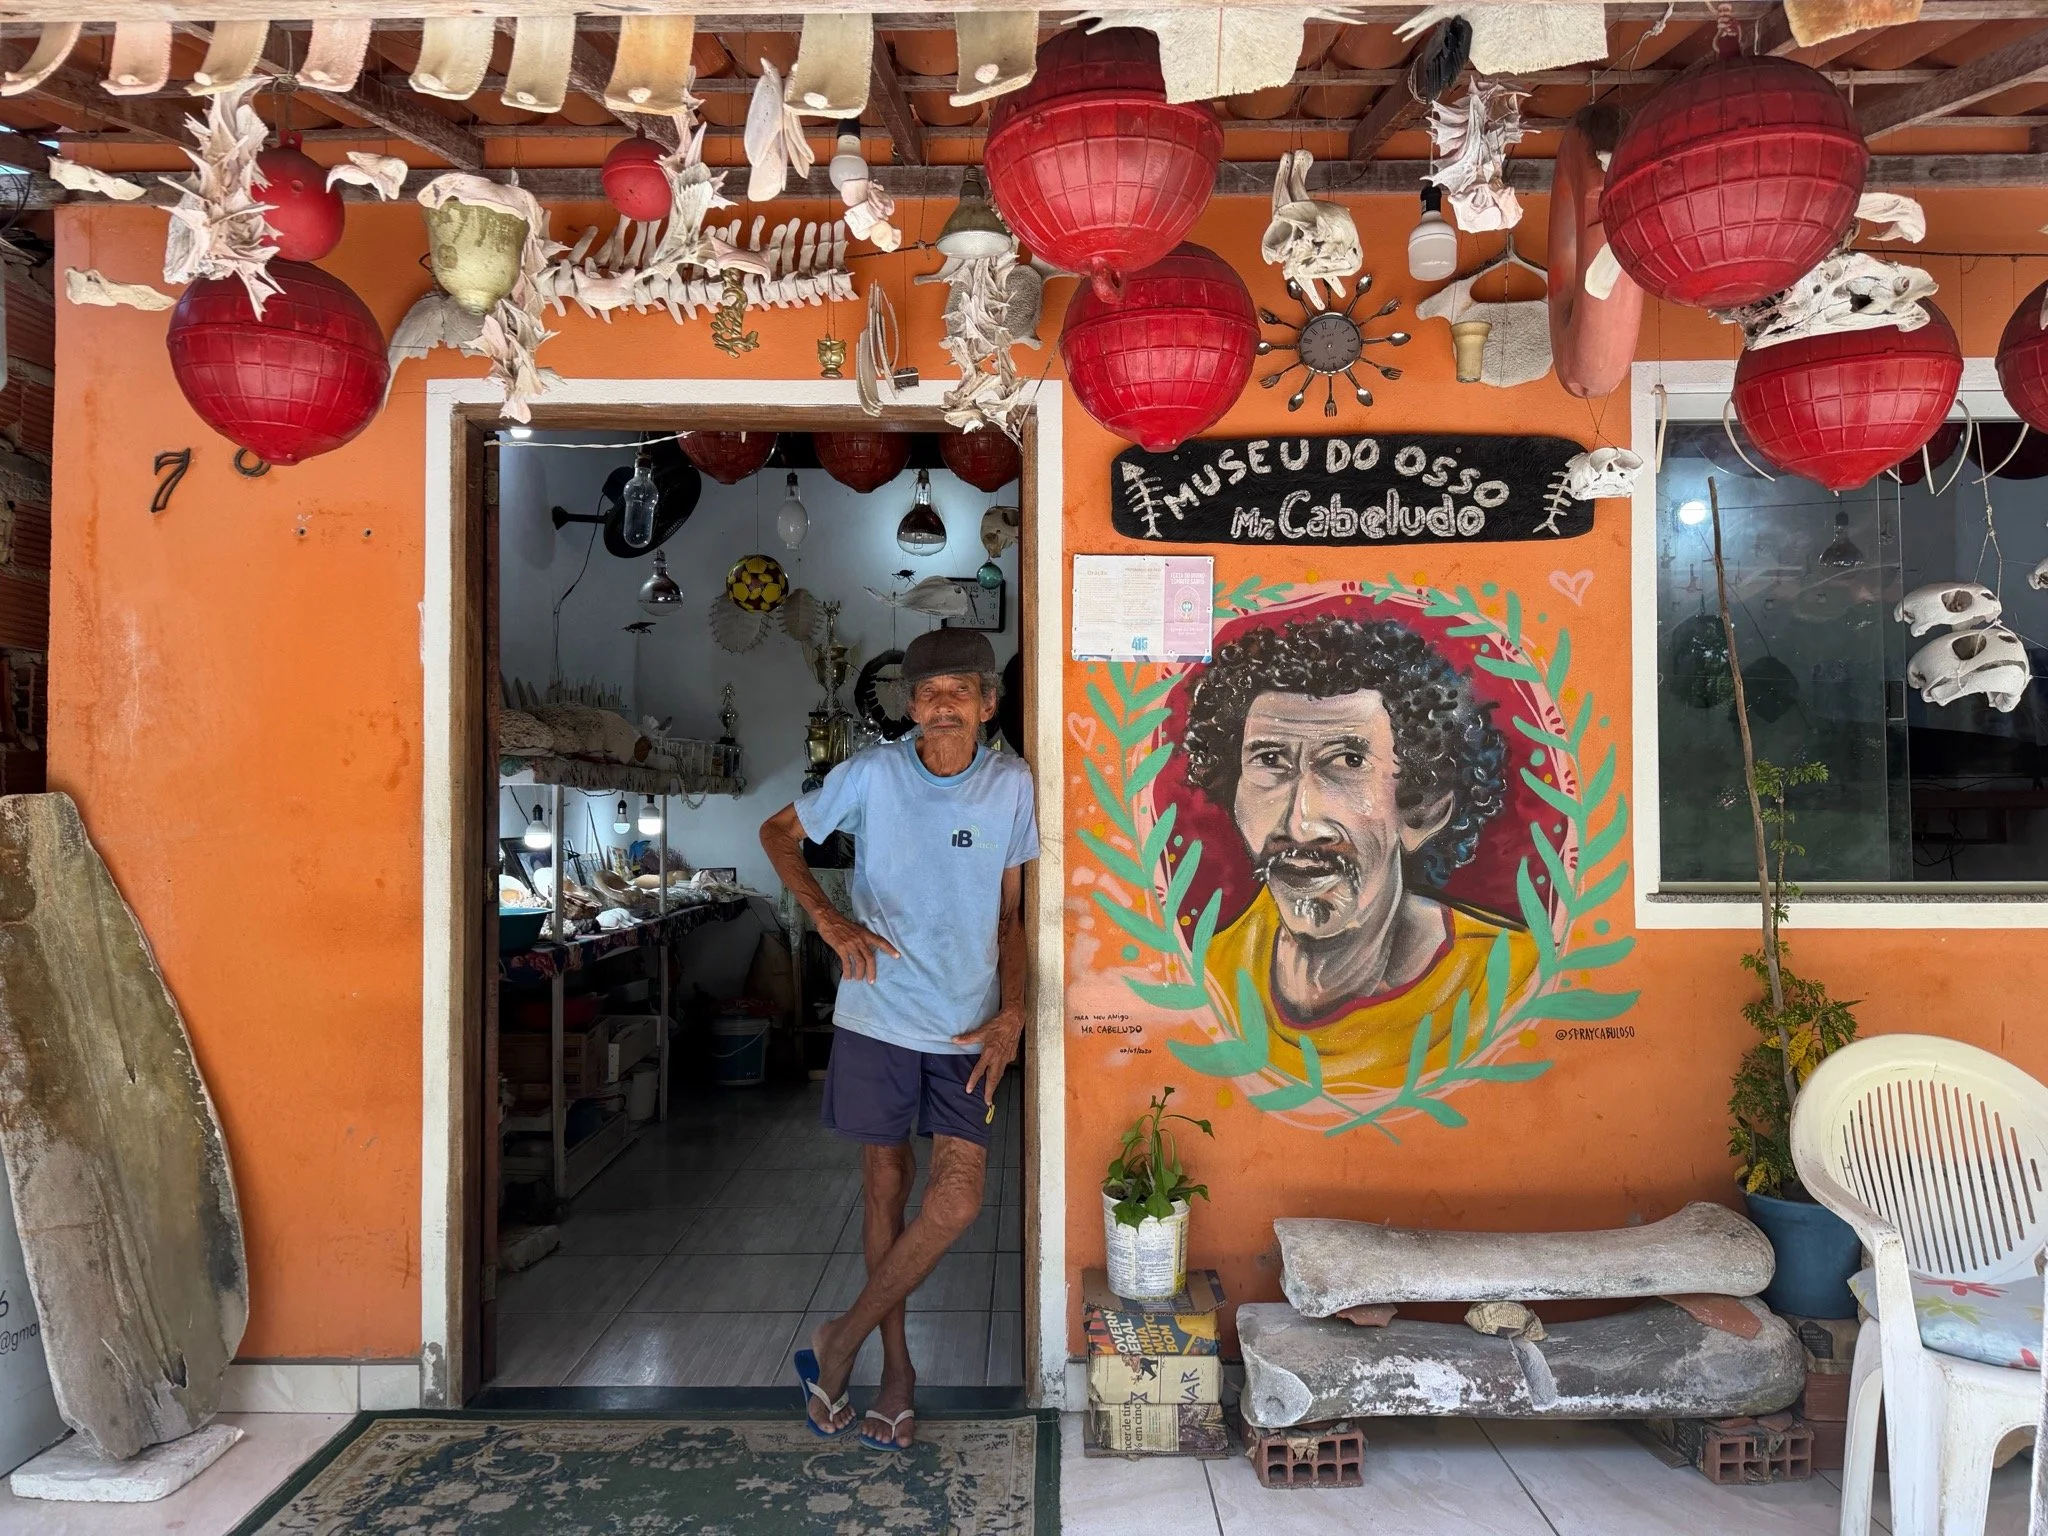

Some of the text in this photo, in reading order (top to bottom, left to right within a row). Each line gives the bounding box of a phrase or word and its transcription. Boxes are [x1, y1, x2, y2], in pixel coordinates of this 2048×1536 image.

[1163, 438, 1510, 520] MUSEU DO OSSO
[1278, 487, 1486, 540] Cabeludo
[1081, 1025, 1143, 1034] MR CABELUDO
[1159, 1324, 1180, 1353] BOM
[1122, 1418, 1132, 1431] de
[1135, 1427, 1143, 1442] em
